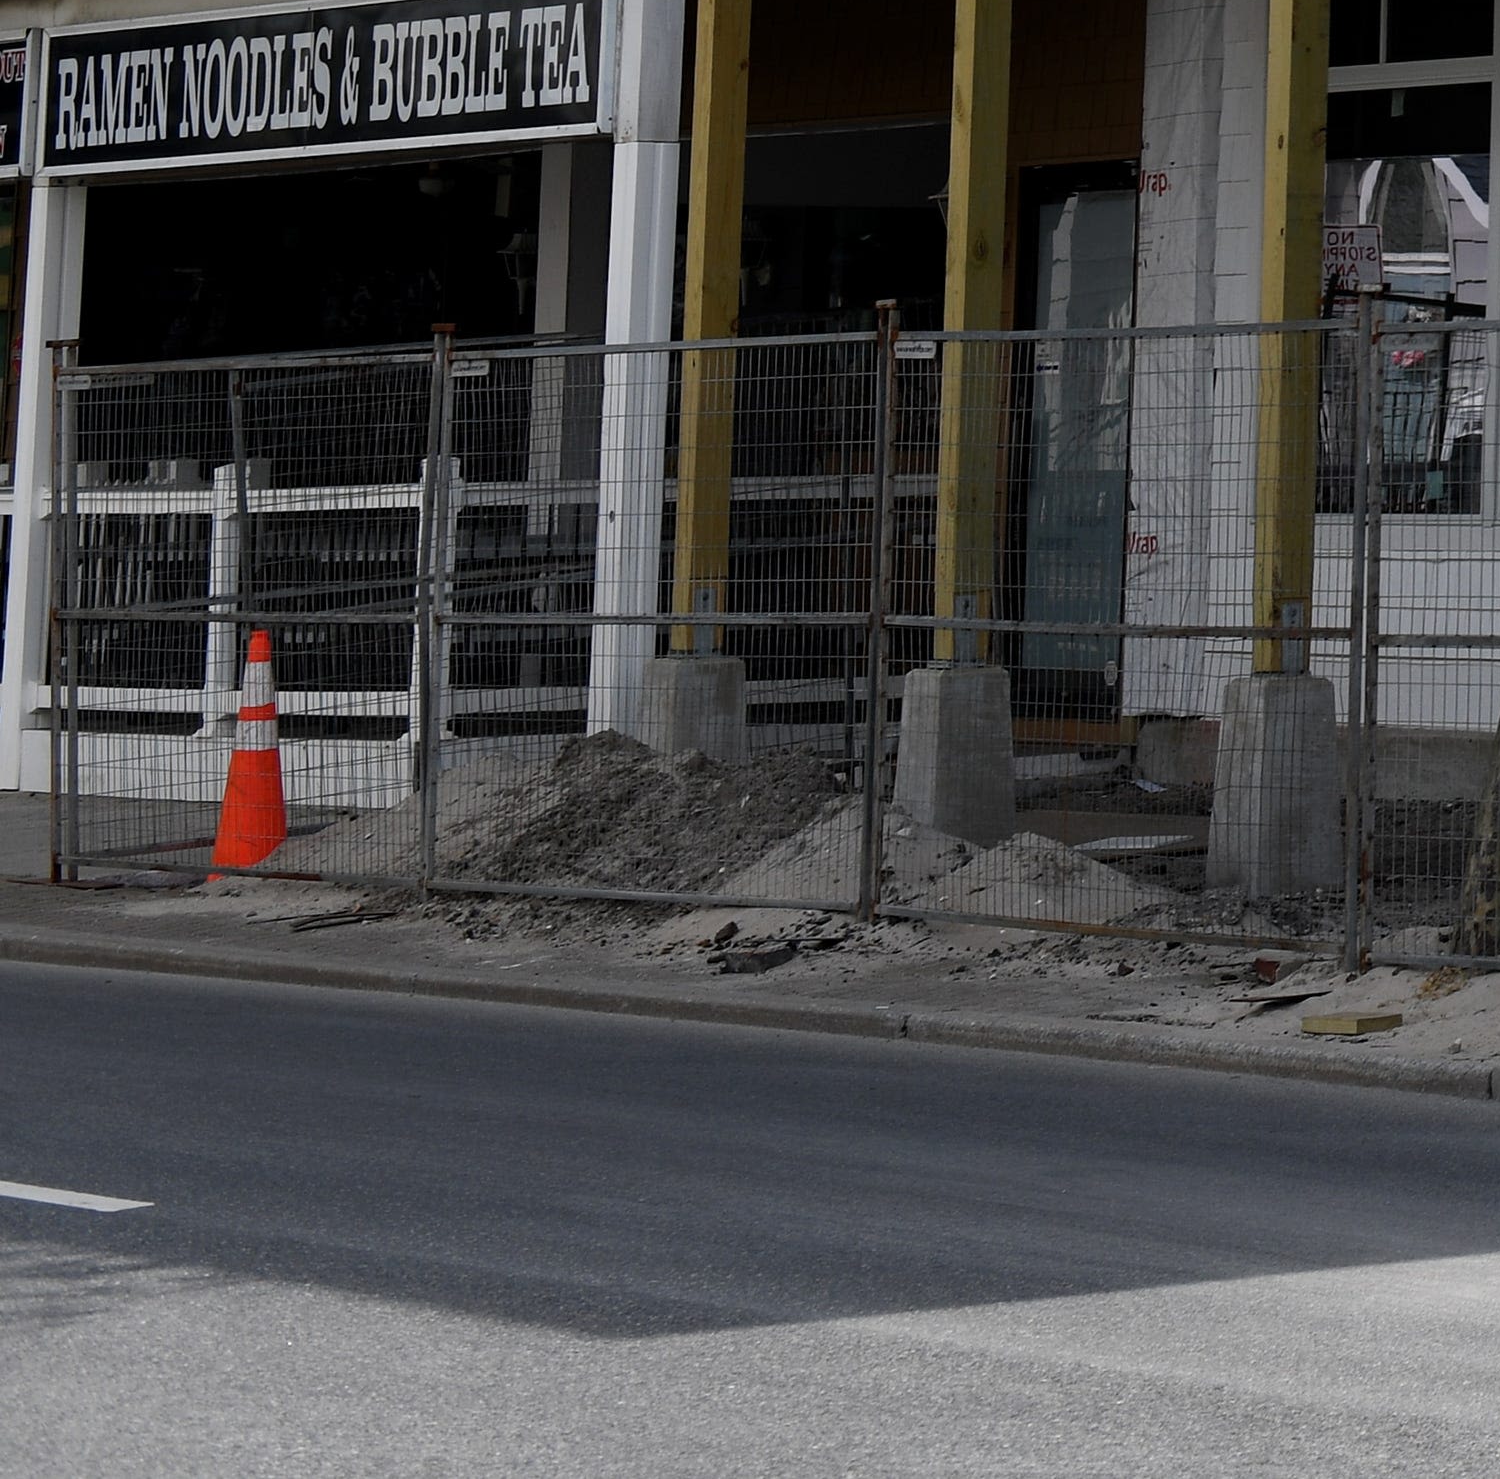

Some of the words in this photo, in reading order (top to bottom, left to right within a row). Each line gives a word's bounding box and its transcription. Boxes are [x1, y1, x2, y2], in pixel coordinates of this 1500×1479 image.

[55, 46, 174, 151] RAMEN
[179, 26, 333, 139] NOODLES
[340, 26, 360, 126] &
[369, 10, 511, 123] BUBBLE
[519, 2, 590, 109] TEA
